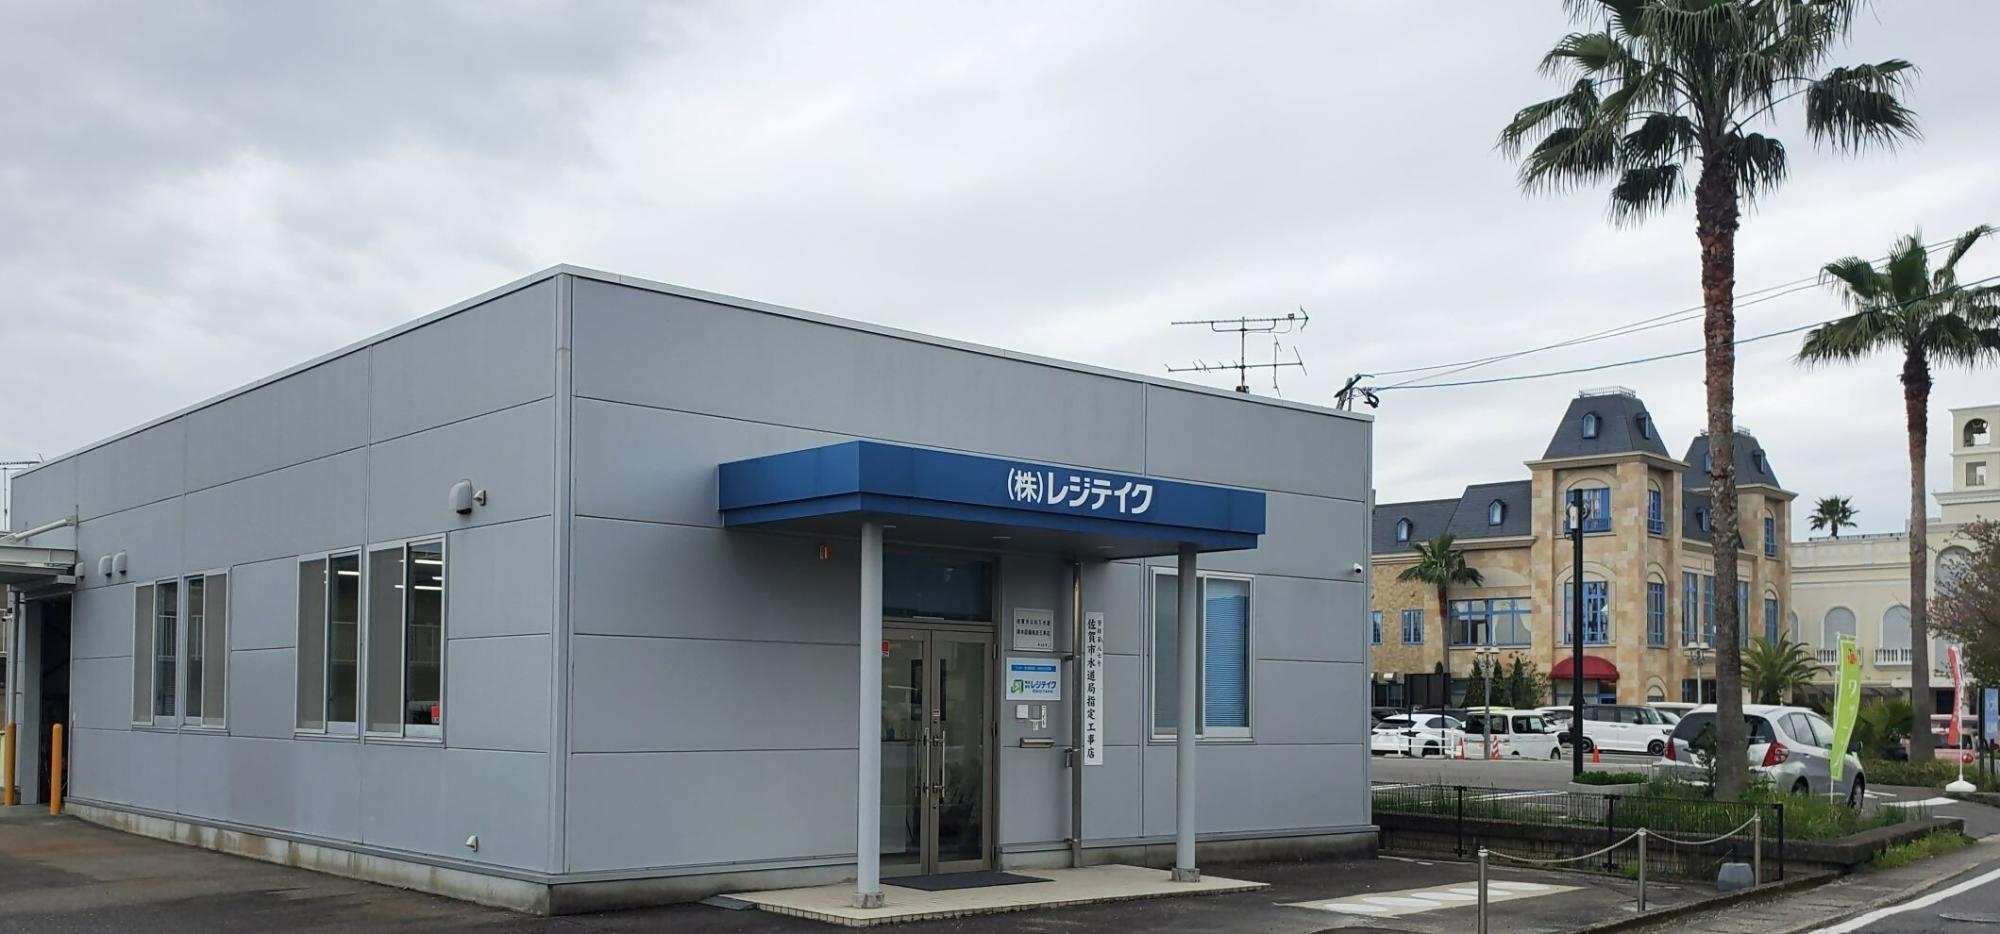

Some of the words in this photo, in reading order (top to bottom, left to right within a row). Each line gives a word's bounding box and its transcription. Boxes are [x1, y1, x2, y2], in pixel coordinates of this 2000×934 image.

[1008, 468, 1153, 514] (株)レジテイク
[1087, 618, 1096, 759] 佐賀市水道局指定工事店
